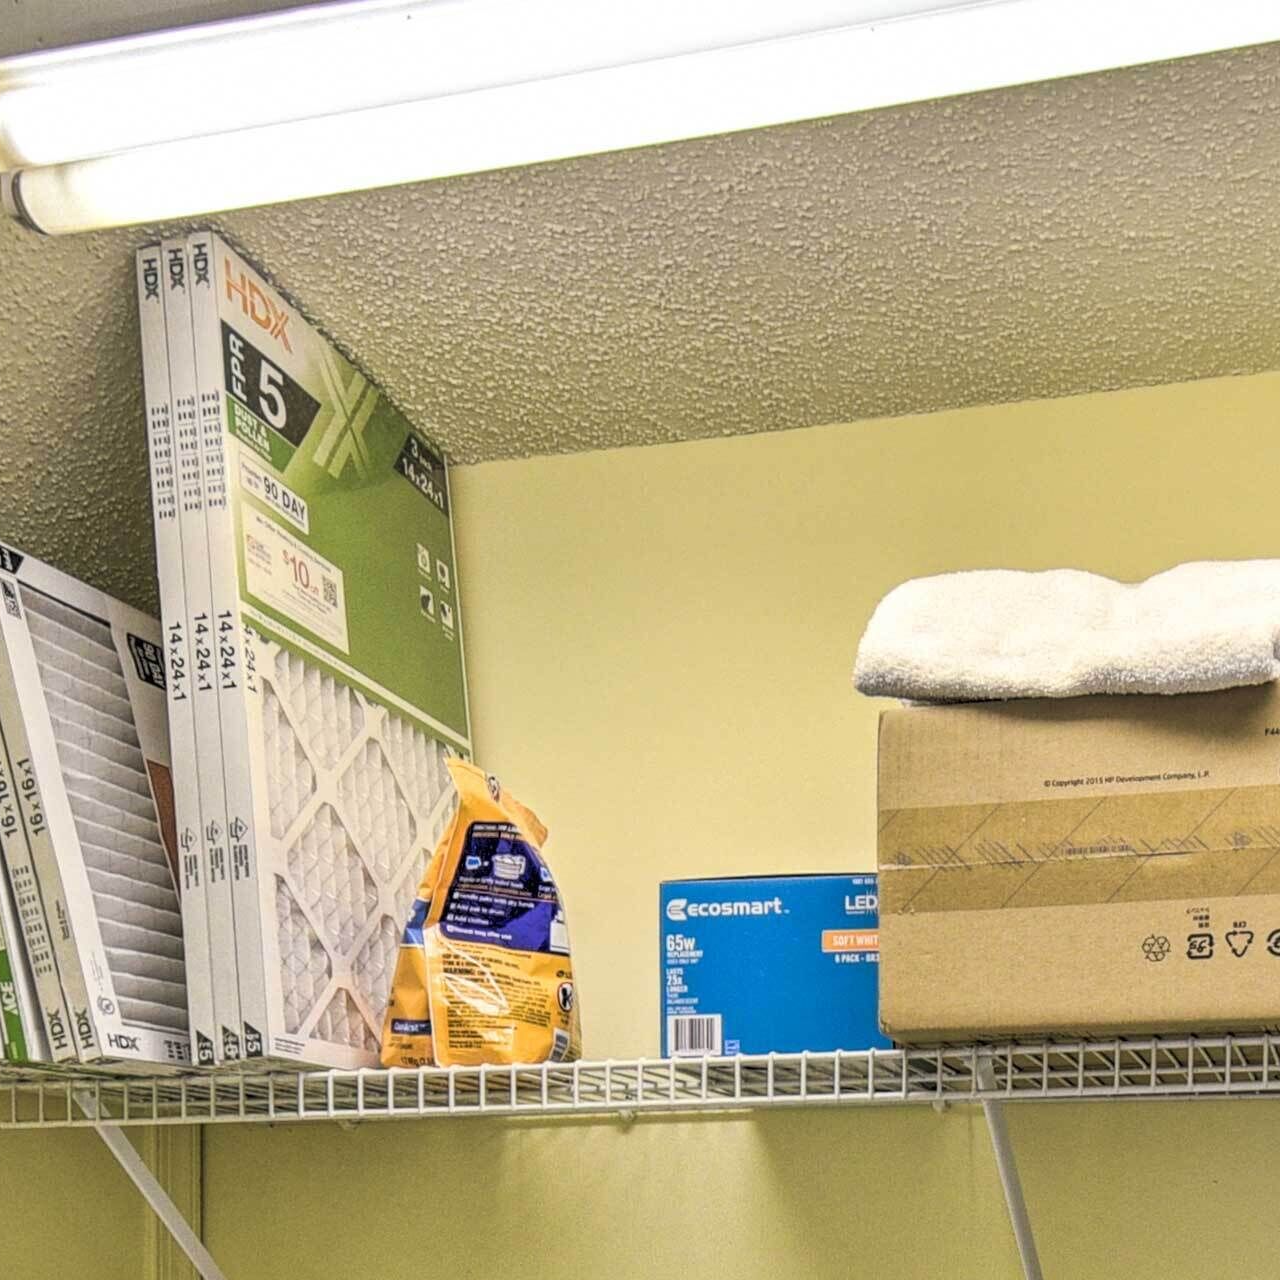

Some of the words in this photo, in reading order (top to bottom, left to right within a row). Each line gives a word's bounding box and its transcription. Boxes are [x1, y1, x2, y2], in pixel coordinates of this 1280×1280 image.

[143, 258, 159, 300] HDX
[168, 248, 185, 290] HDX
[193, 243, 209, 286] HDX
[224, 256, 293, 354] HDX
[229, 333, 247, 402] FPR
[259, 359, 287, 429] 5
[410, 438, 419, 459] 3
[264, 476, 278, 500] 90
[282, 490, 306, 520] DAY
[1052, 777, 1085, 789] Copyright
[1105, 776, 1115, 785] HP
[1116, 773, 1162, 785] Development
[687, 896, 782, 917] ecosmart
[844, 894, 879, 911] LED
[832, 936, 855, 947] SOFT
[857, 934, 879, 946] WHIT
[841, 954, 861, 963] PACK
[0, 981, 19, 1016] ACE
[47, 1007, 68, 1050] HDX
[74, 1006, 95, 1050] HDX
[107, 1033, 140, 1051] HDX
